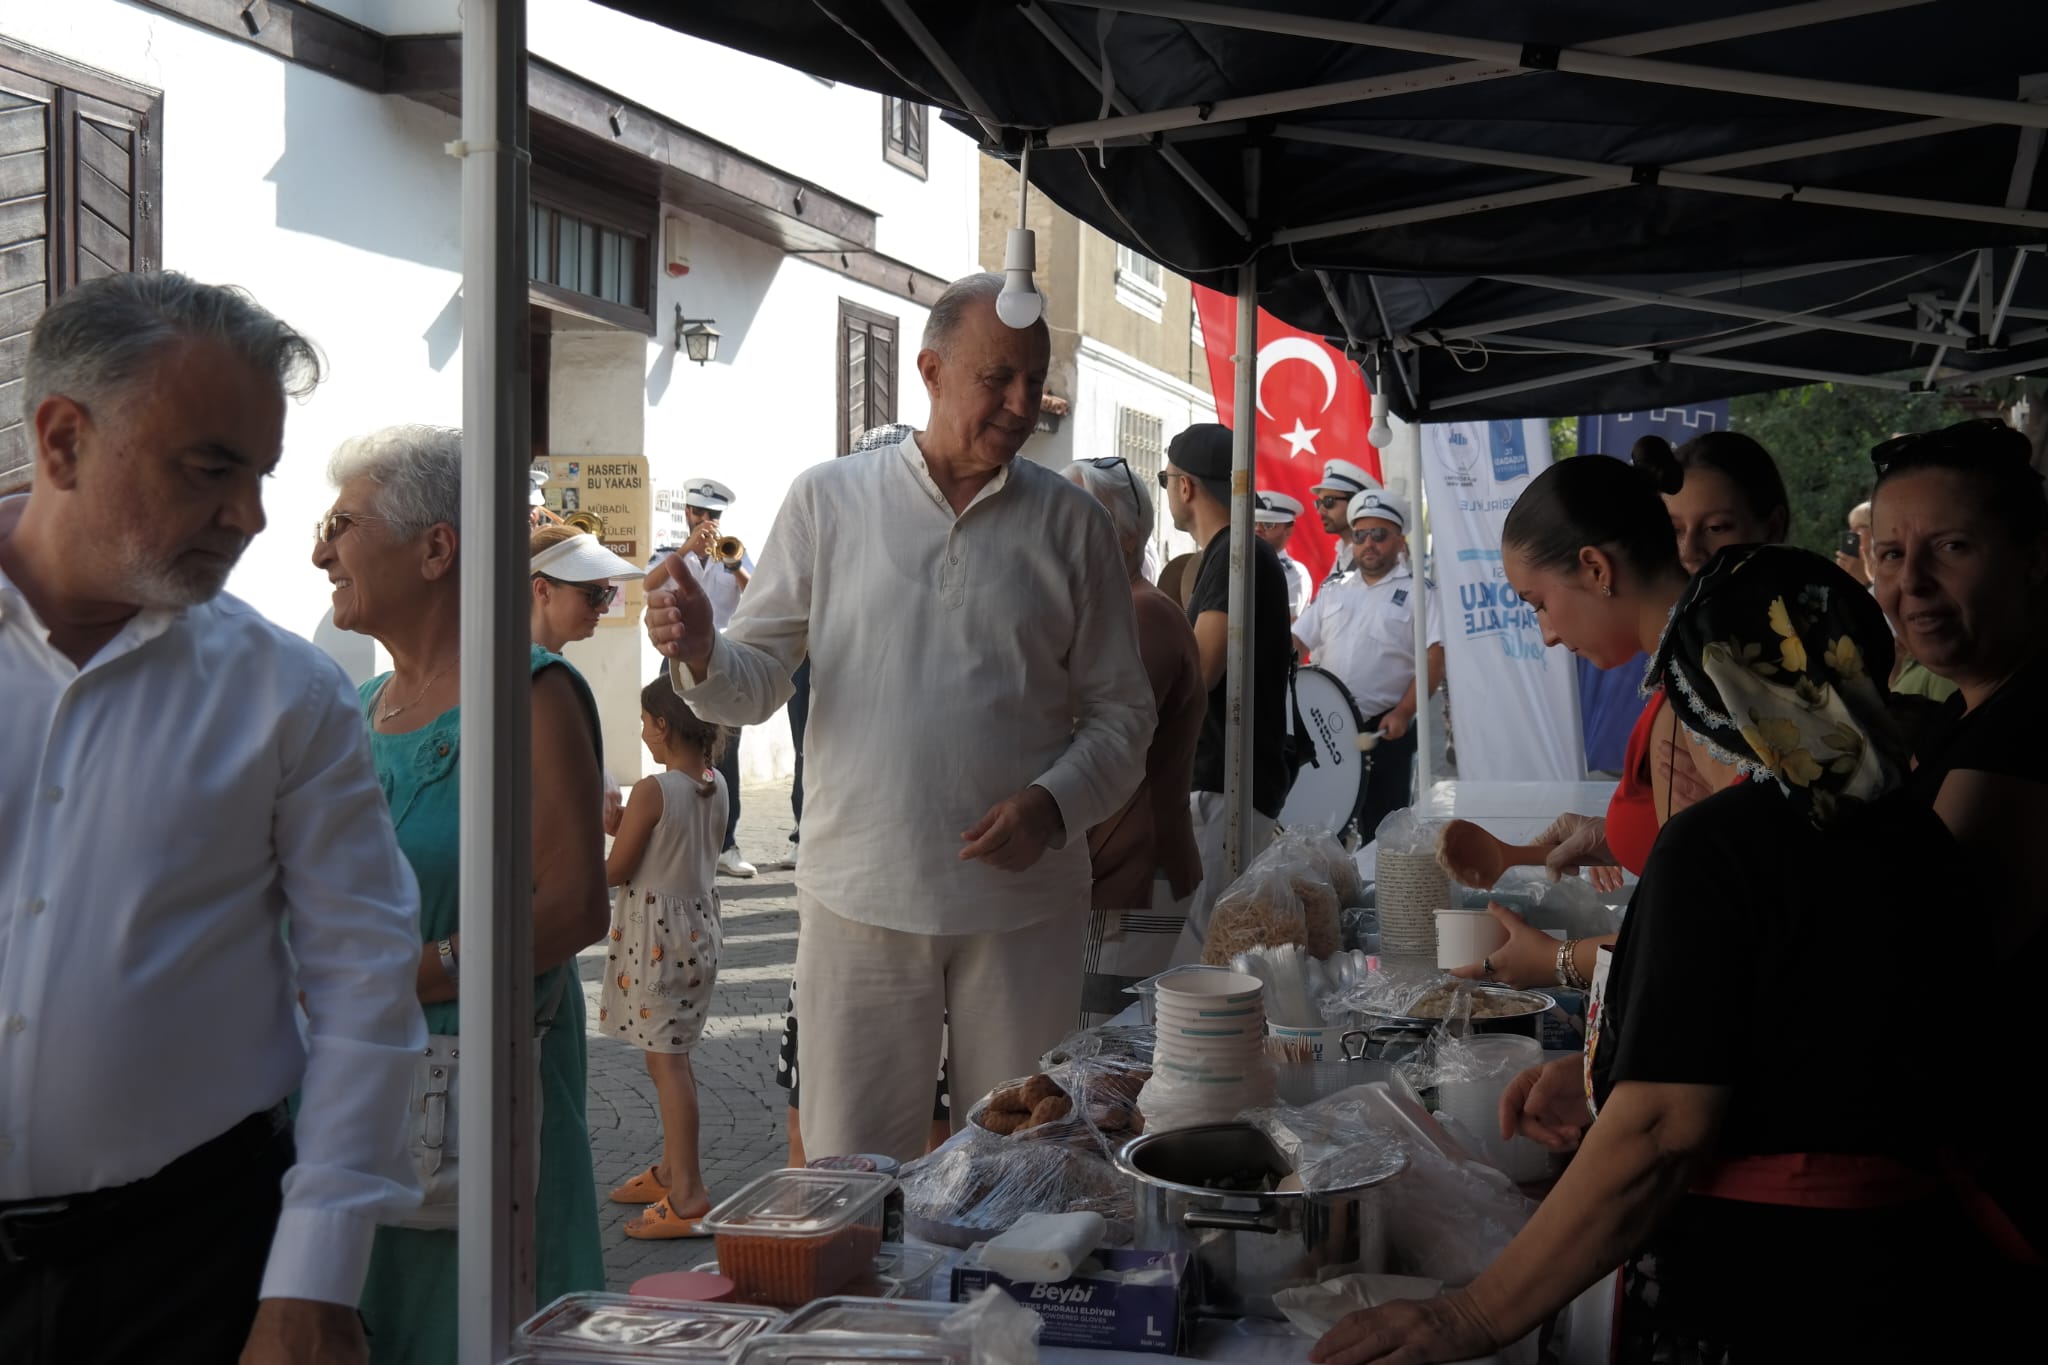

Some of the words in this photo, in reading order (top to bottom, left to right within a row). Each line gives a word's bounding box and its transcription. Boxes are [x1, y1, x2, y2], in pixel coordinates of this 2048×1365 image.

[587, 461, 638, 476] HASRETİN
[588, 478, 602, 489] BU
[605, 477, 642, 489] YAKASI
[587, 503, 630, 514] MÜBADİL
[602, 526, 636, 537] KÜLERİ
[1029, 1282, 1094, 1304] Beybi
[1042, 1303, 1078, 1313] PUDRALI
[1080, 1305, 1116, 1317] ELDİVEN
[1146, 1315, 1162, 1337] L
